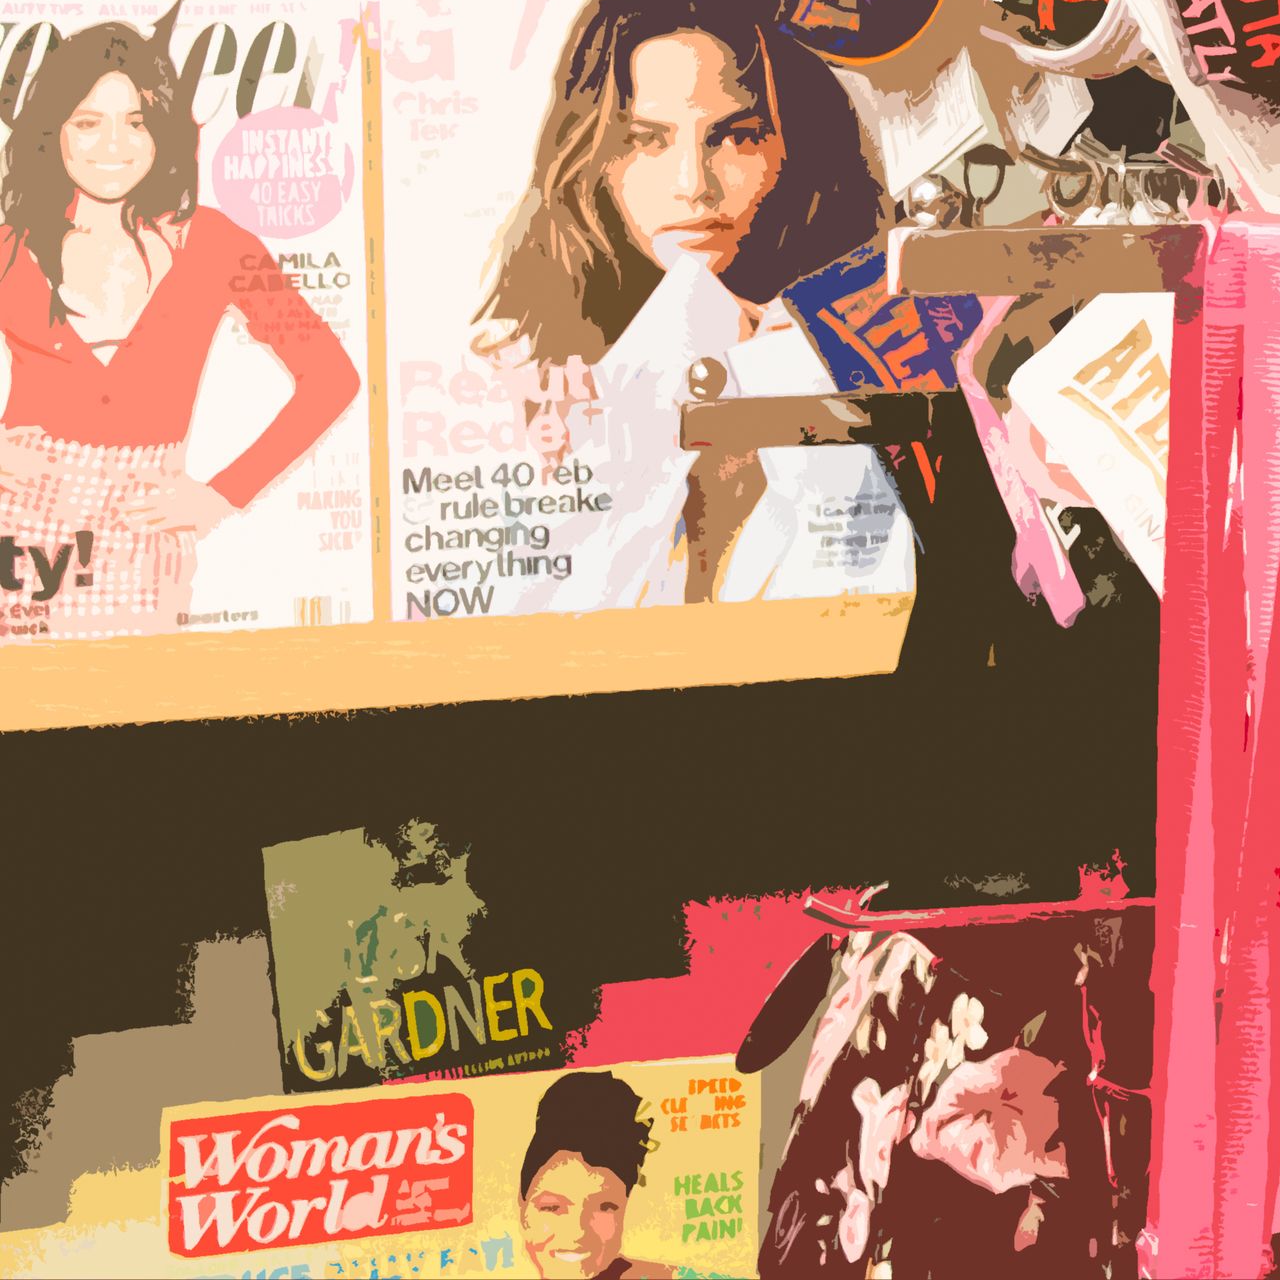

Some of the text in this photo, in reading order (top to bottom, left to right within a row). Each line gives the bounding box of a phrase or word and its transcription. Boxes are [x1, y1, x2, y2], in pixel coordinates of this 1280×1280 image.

[241, 128, 329, 156] INSTANT
[249, 181, 321, 204] 40 EASY
[257, 203, 316, 227] TRICKS
[239, 251, 341, 271] CAMILA
[228, 272, 350, 293] CABELLO
[491, 462, 535, 487] 40
[331, 509, 361, 529] YOU
[440, 491, 499, 521] rule
[404, 521, 551, 553] changing
[406, 552, 573, 584] everything
[406, 586, 495, 619] NOW
[295, 967, 553, 1082] GARDNER
[176, 1111, 468, 1189] Woman's
[674, 1170, 744, 1196] HEALS
[177, 1174, 390, 1252] World
[685, 1193, 743, 1220] BACK
